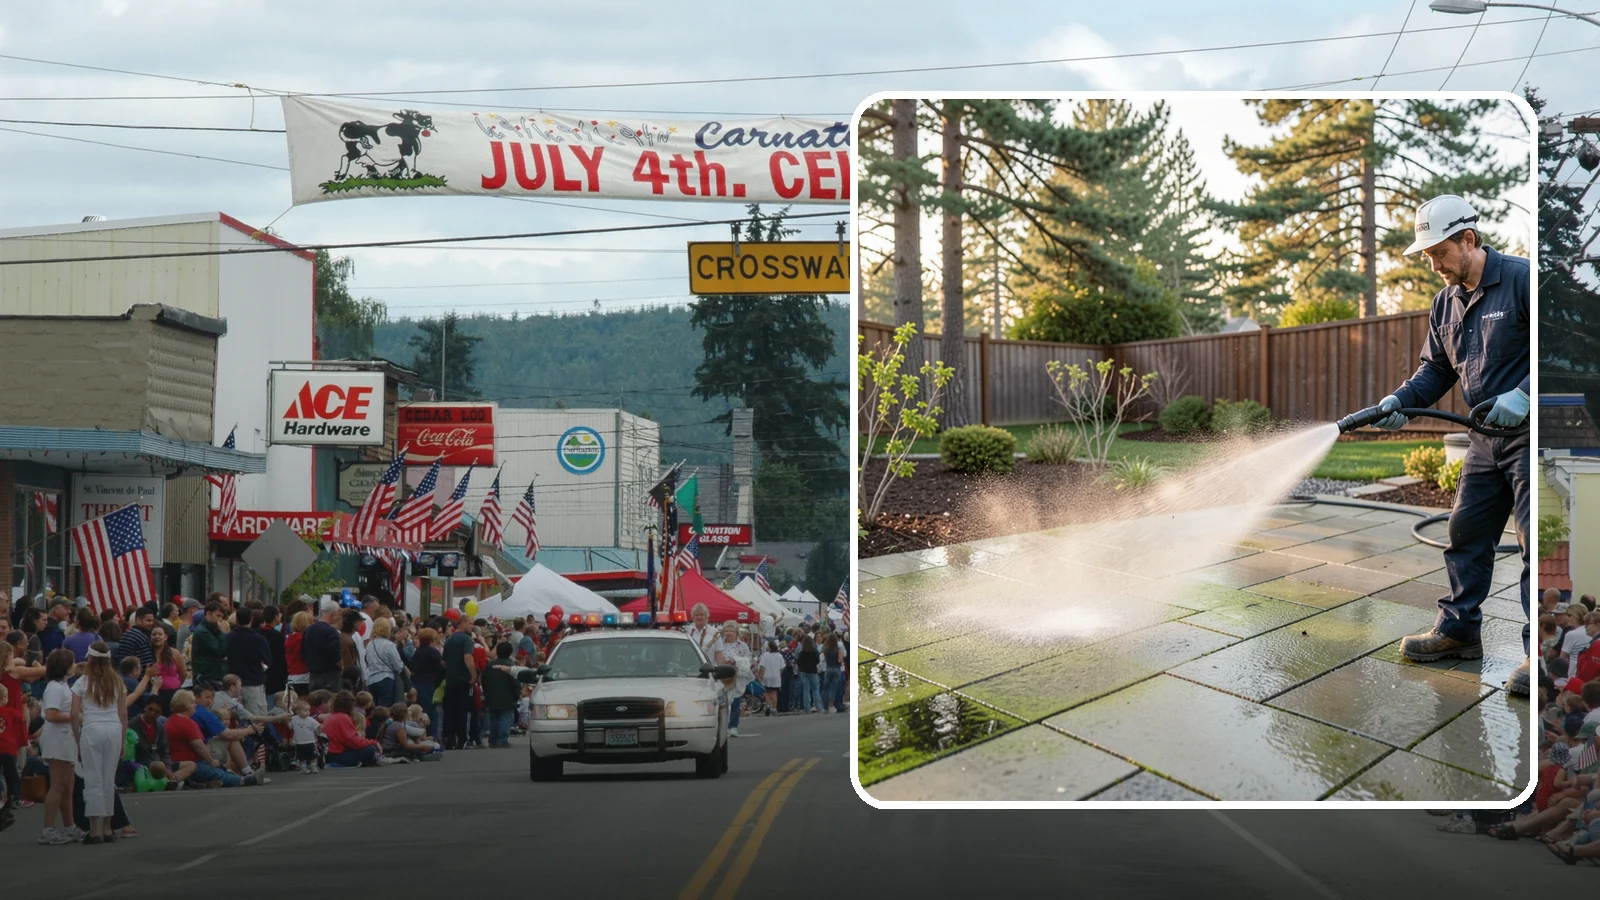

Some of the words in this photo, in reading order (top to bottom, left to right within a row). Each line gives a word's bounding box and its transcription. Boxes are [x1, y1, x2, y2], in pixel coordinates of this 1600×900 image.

[481, 141, 605, 192] JULY
[632, 150, 746, 198] 4th.
[696, 254, 850, 280] CROSSWA
[282, 380, 374, 420] ACE
[405, 409, 452, 422] CEDAR
[283, 421, 371, 437] Hardware
[416, 428, 477, 447] Coca-Cola
[95, 485, 124, 495] Vincent
[126, 486, 136, 495] de
[137, 486, 155, 495] Paul
[81, 503, 154, 522] THT
[688, 526, 742, 535] CRNATION
[699, 535, 730, 543] GLASS
